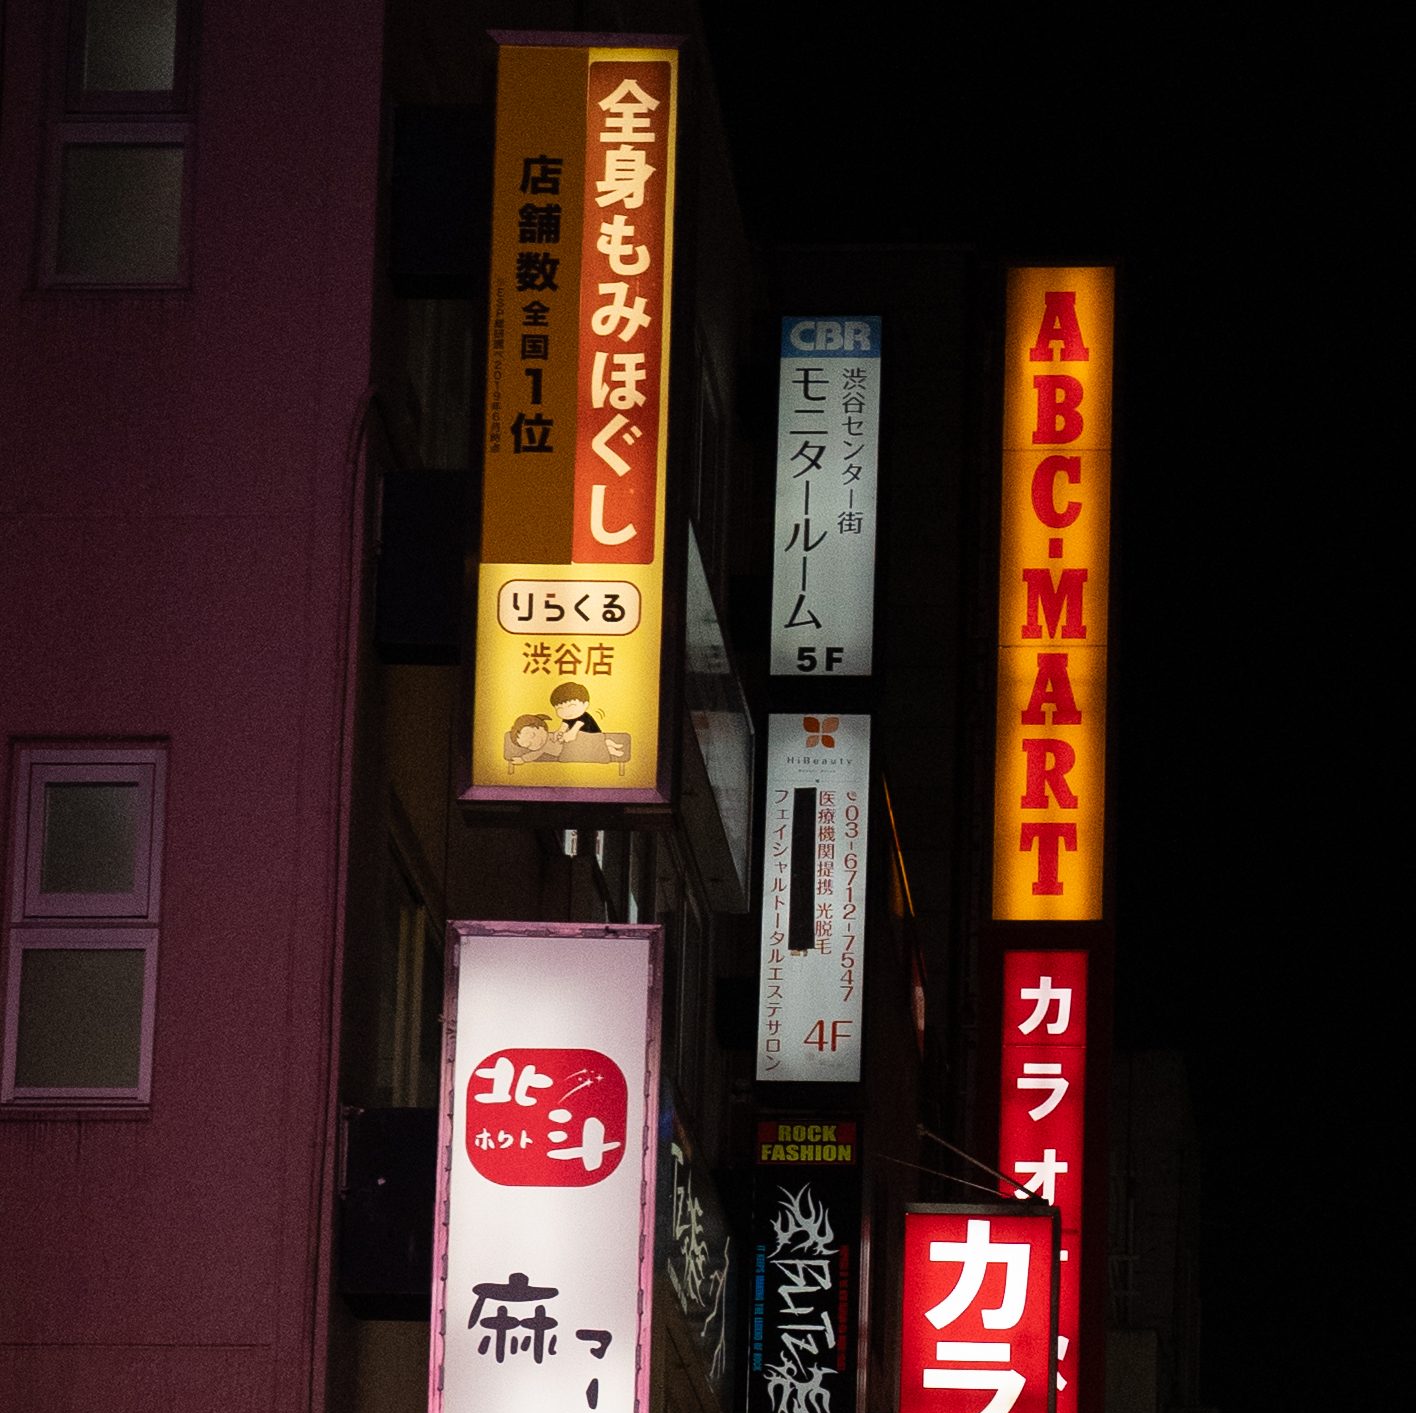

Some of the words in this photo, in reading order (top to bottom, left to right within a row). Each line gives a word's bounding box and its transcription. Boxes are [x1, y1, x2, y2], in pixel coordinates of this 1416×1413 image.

[509, 154, 564, 455] 店舗数全国1位
[589, 78, 661, 547] 全身もみほぐし
[789, 320, 872, 352] CBR
[837, 367, 868, 535] 渋谷センター街
[784, 366, 830, 630] モニタールーム
[511, 590, 626, 624] りらくる
[521, 642, 616, 678] 渋谷店
[796, 646, 845, 673] 5F
[816, 790, 836, 896] 医療機関提携
[765, 788, 791, 1072] フェイシャルトータルエステサロン
[814, 902, 834, 956] 光脱毛
[839, 805, 859, 1003] 03-6712-7547
[803, 1018, 854, 1053] 4F
[473, 1055, 623, 1172] 北斗
[473, 1129, 534, 1150] ホクト
[777, 1124, 837, 1144] ROCK
[760, 1143, 852, 1163] FASHION
